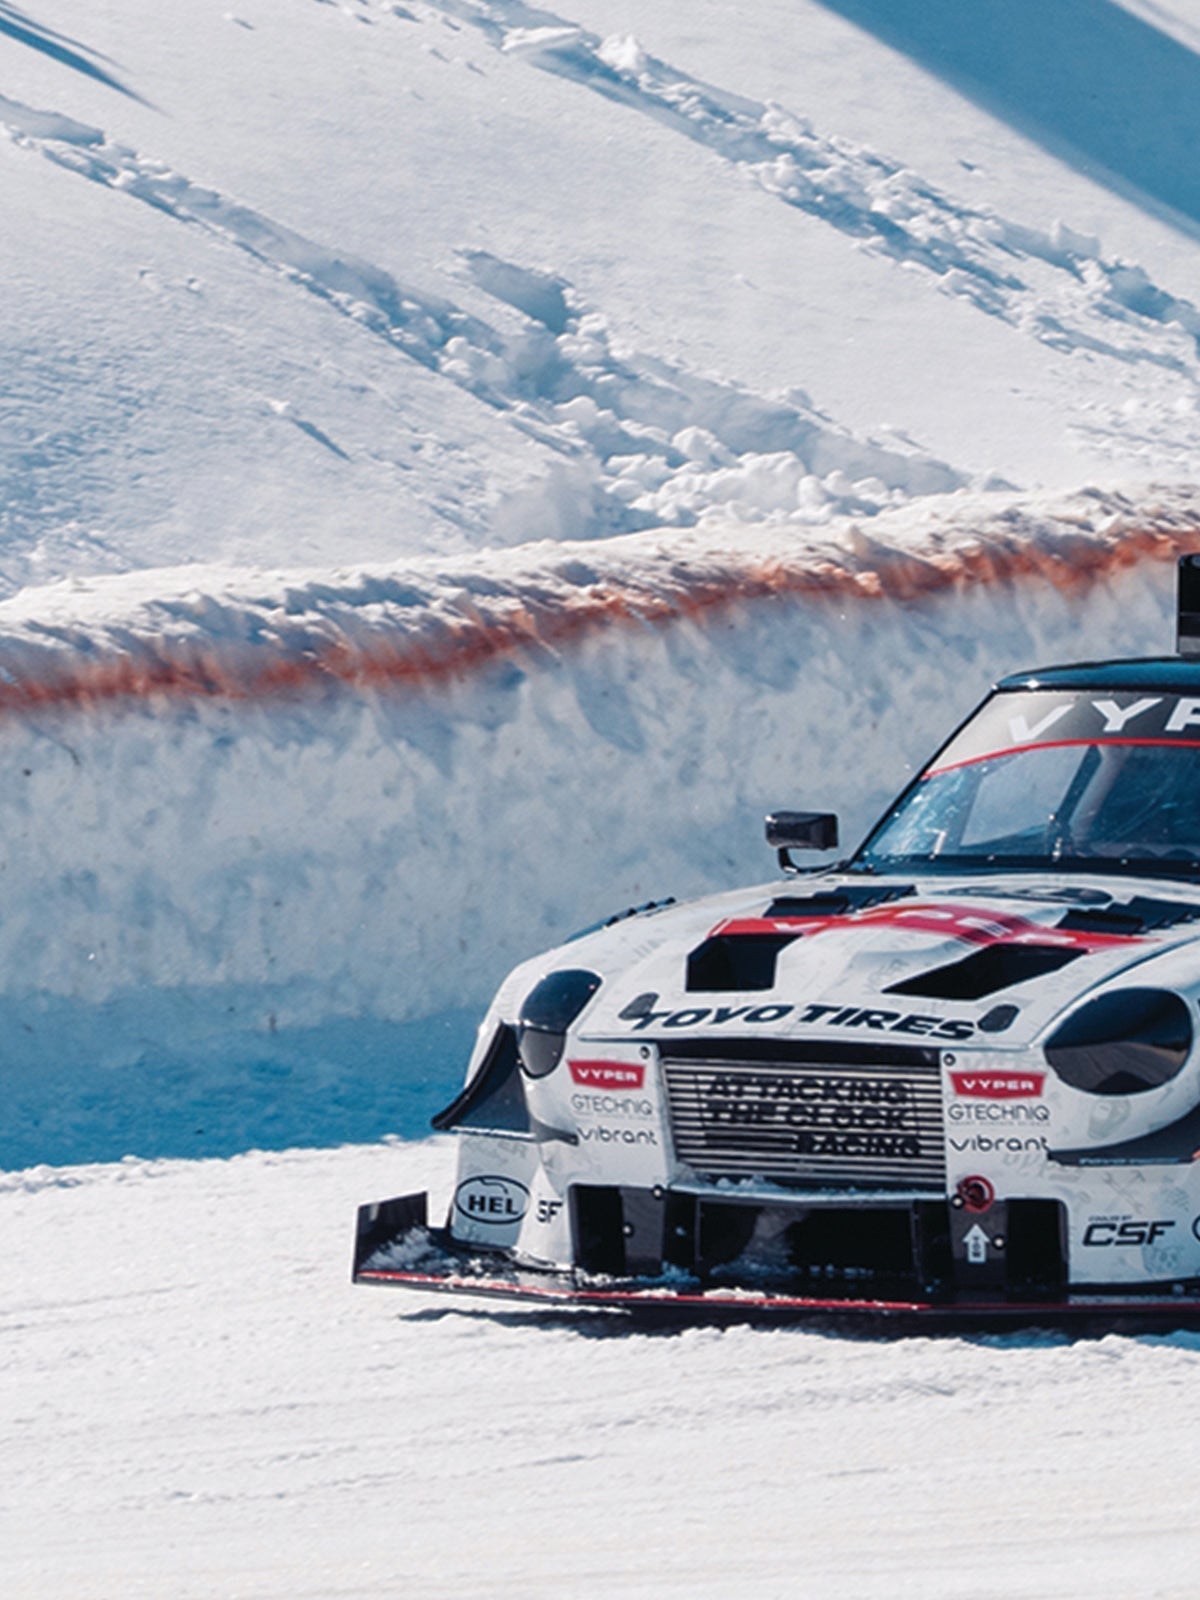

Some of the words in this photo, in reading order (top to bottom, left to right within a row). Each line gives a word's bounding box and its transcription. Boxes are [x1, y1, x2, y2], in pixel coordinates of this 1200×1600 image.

[632, 1004, 796, 1031] TOYO
[797, 1003, 976, 1041] TIRES
[577, 1068, 638, 1082] VYPER
[962, 1078, 1035, 1091] VYPER
[577, 1126, 658, 1146] vibrant
[948, 1135, 1052, 1152] vibrant
[467, 1194, 520, 1215] HEL
[1082, 1220, 1176, 1247] CSF
